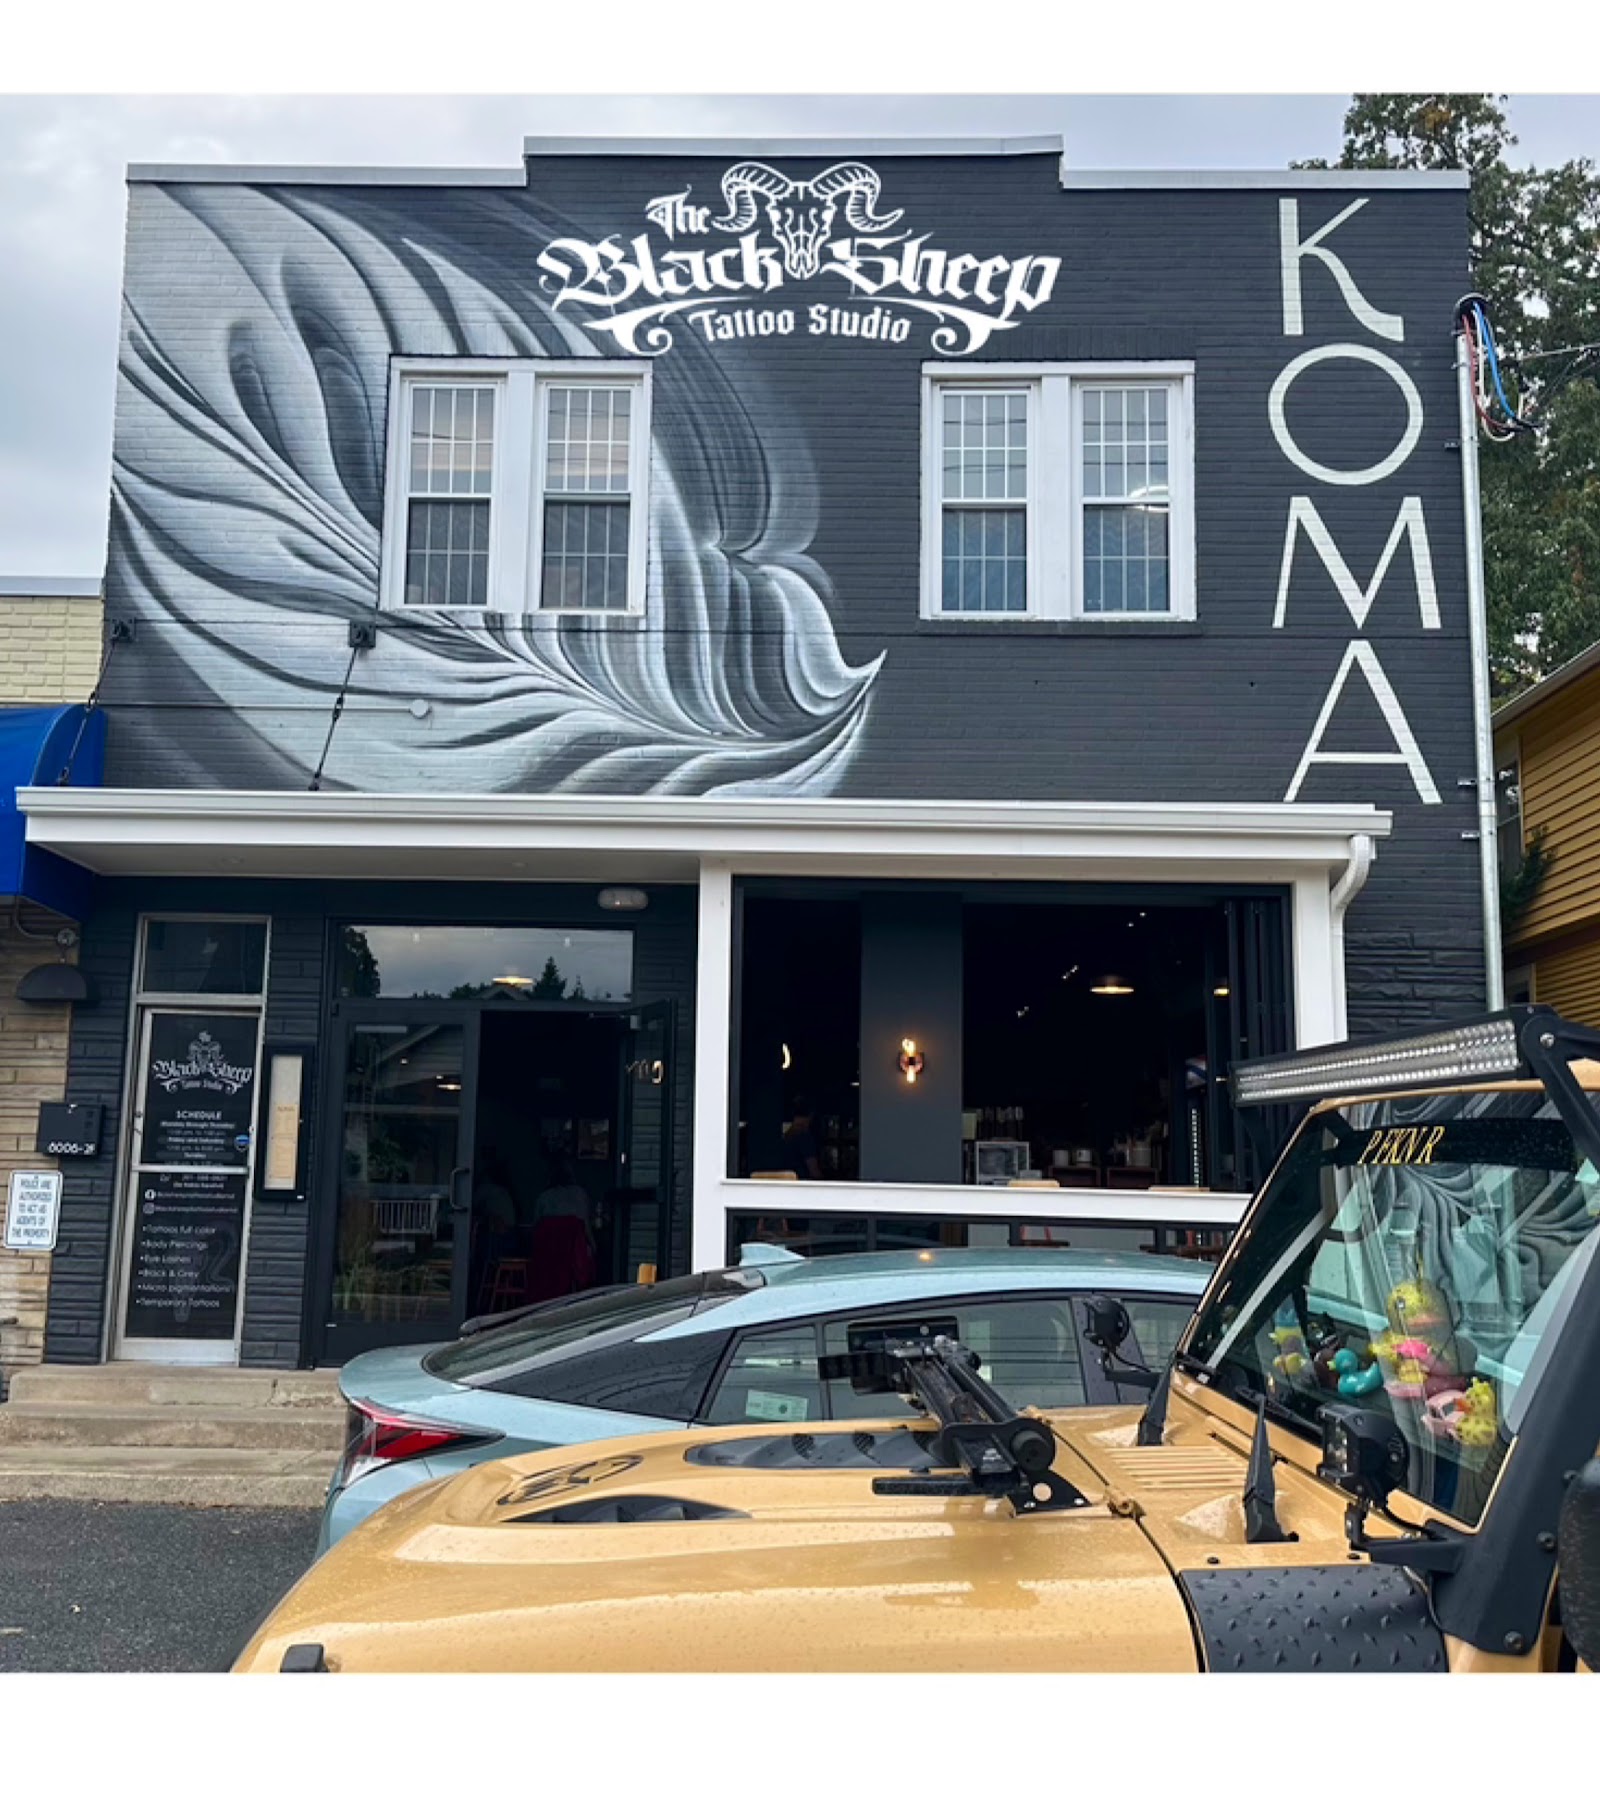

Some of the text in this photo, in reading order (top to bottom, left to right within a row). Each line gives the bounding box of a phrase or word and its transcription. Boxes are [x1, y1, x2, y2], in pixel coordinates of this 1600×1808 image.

[645, 185, 713, 241] The
[537, 230, 1062, 321] Black Sheep
[688, 303, 910, 343] Tattoo Studio
[1268, 198, 1443, 805] KOMA
[176, 1110, 222, 1119] SCHEDULE
